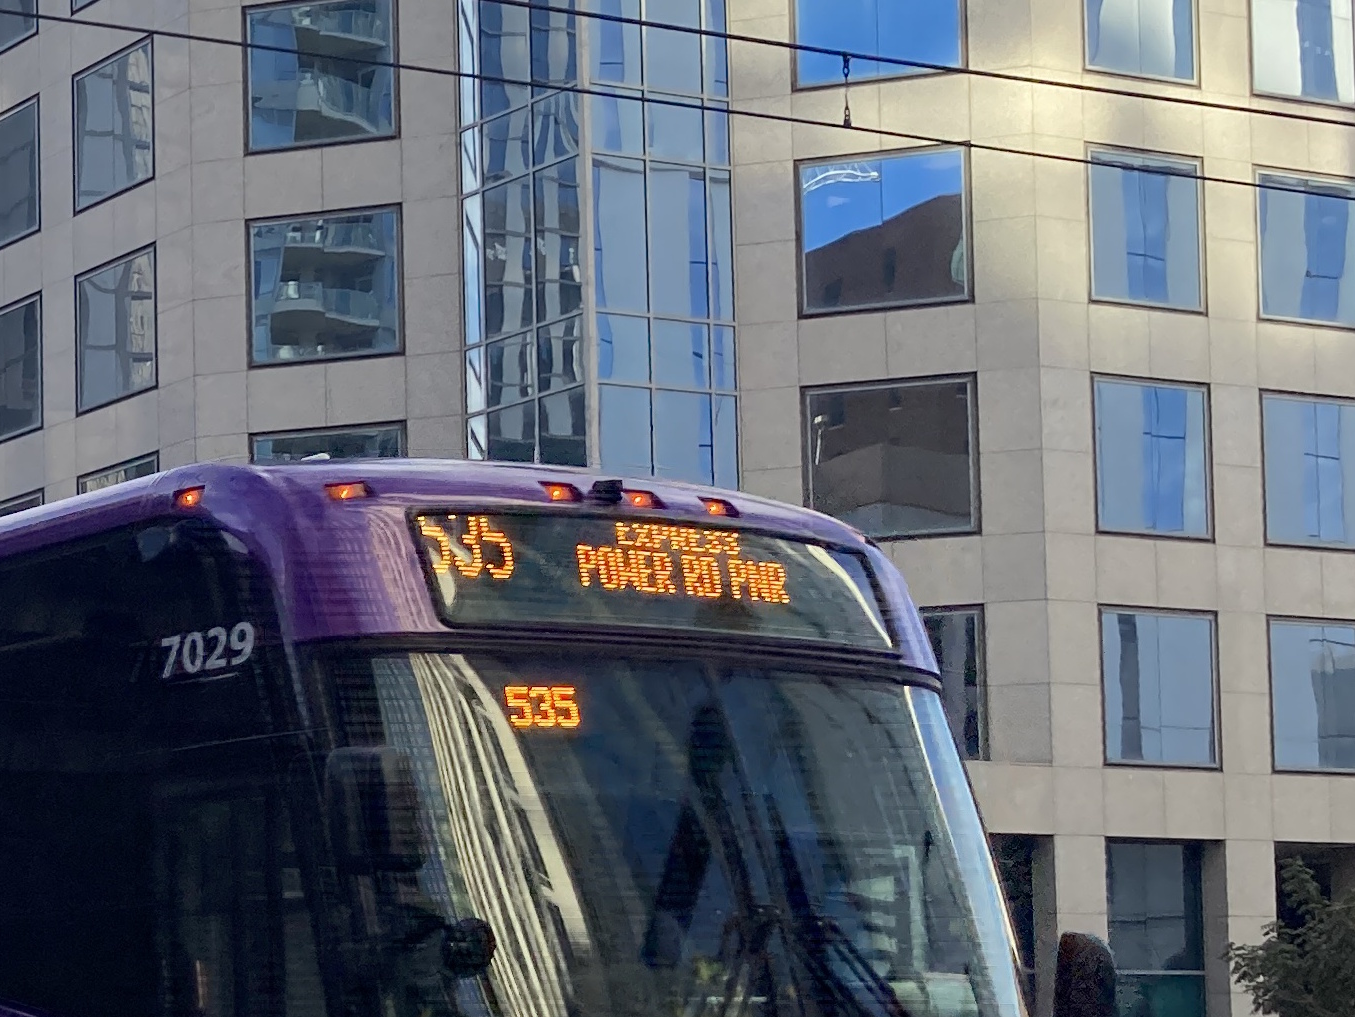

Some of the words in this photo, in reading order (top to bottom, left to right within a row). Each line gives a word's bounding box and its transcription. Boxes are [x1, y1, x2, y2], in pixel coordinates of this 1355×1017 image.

[576, 542, 676, 594] POWER
[680, 553, 722, 598] RD
[727, 557, 790, 604] PNR
[161, 621, 255, 679] 7029
[504, 685, 581, 729] 535
